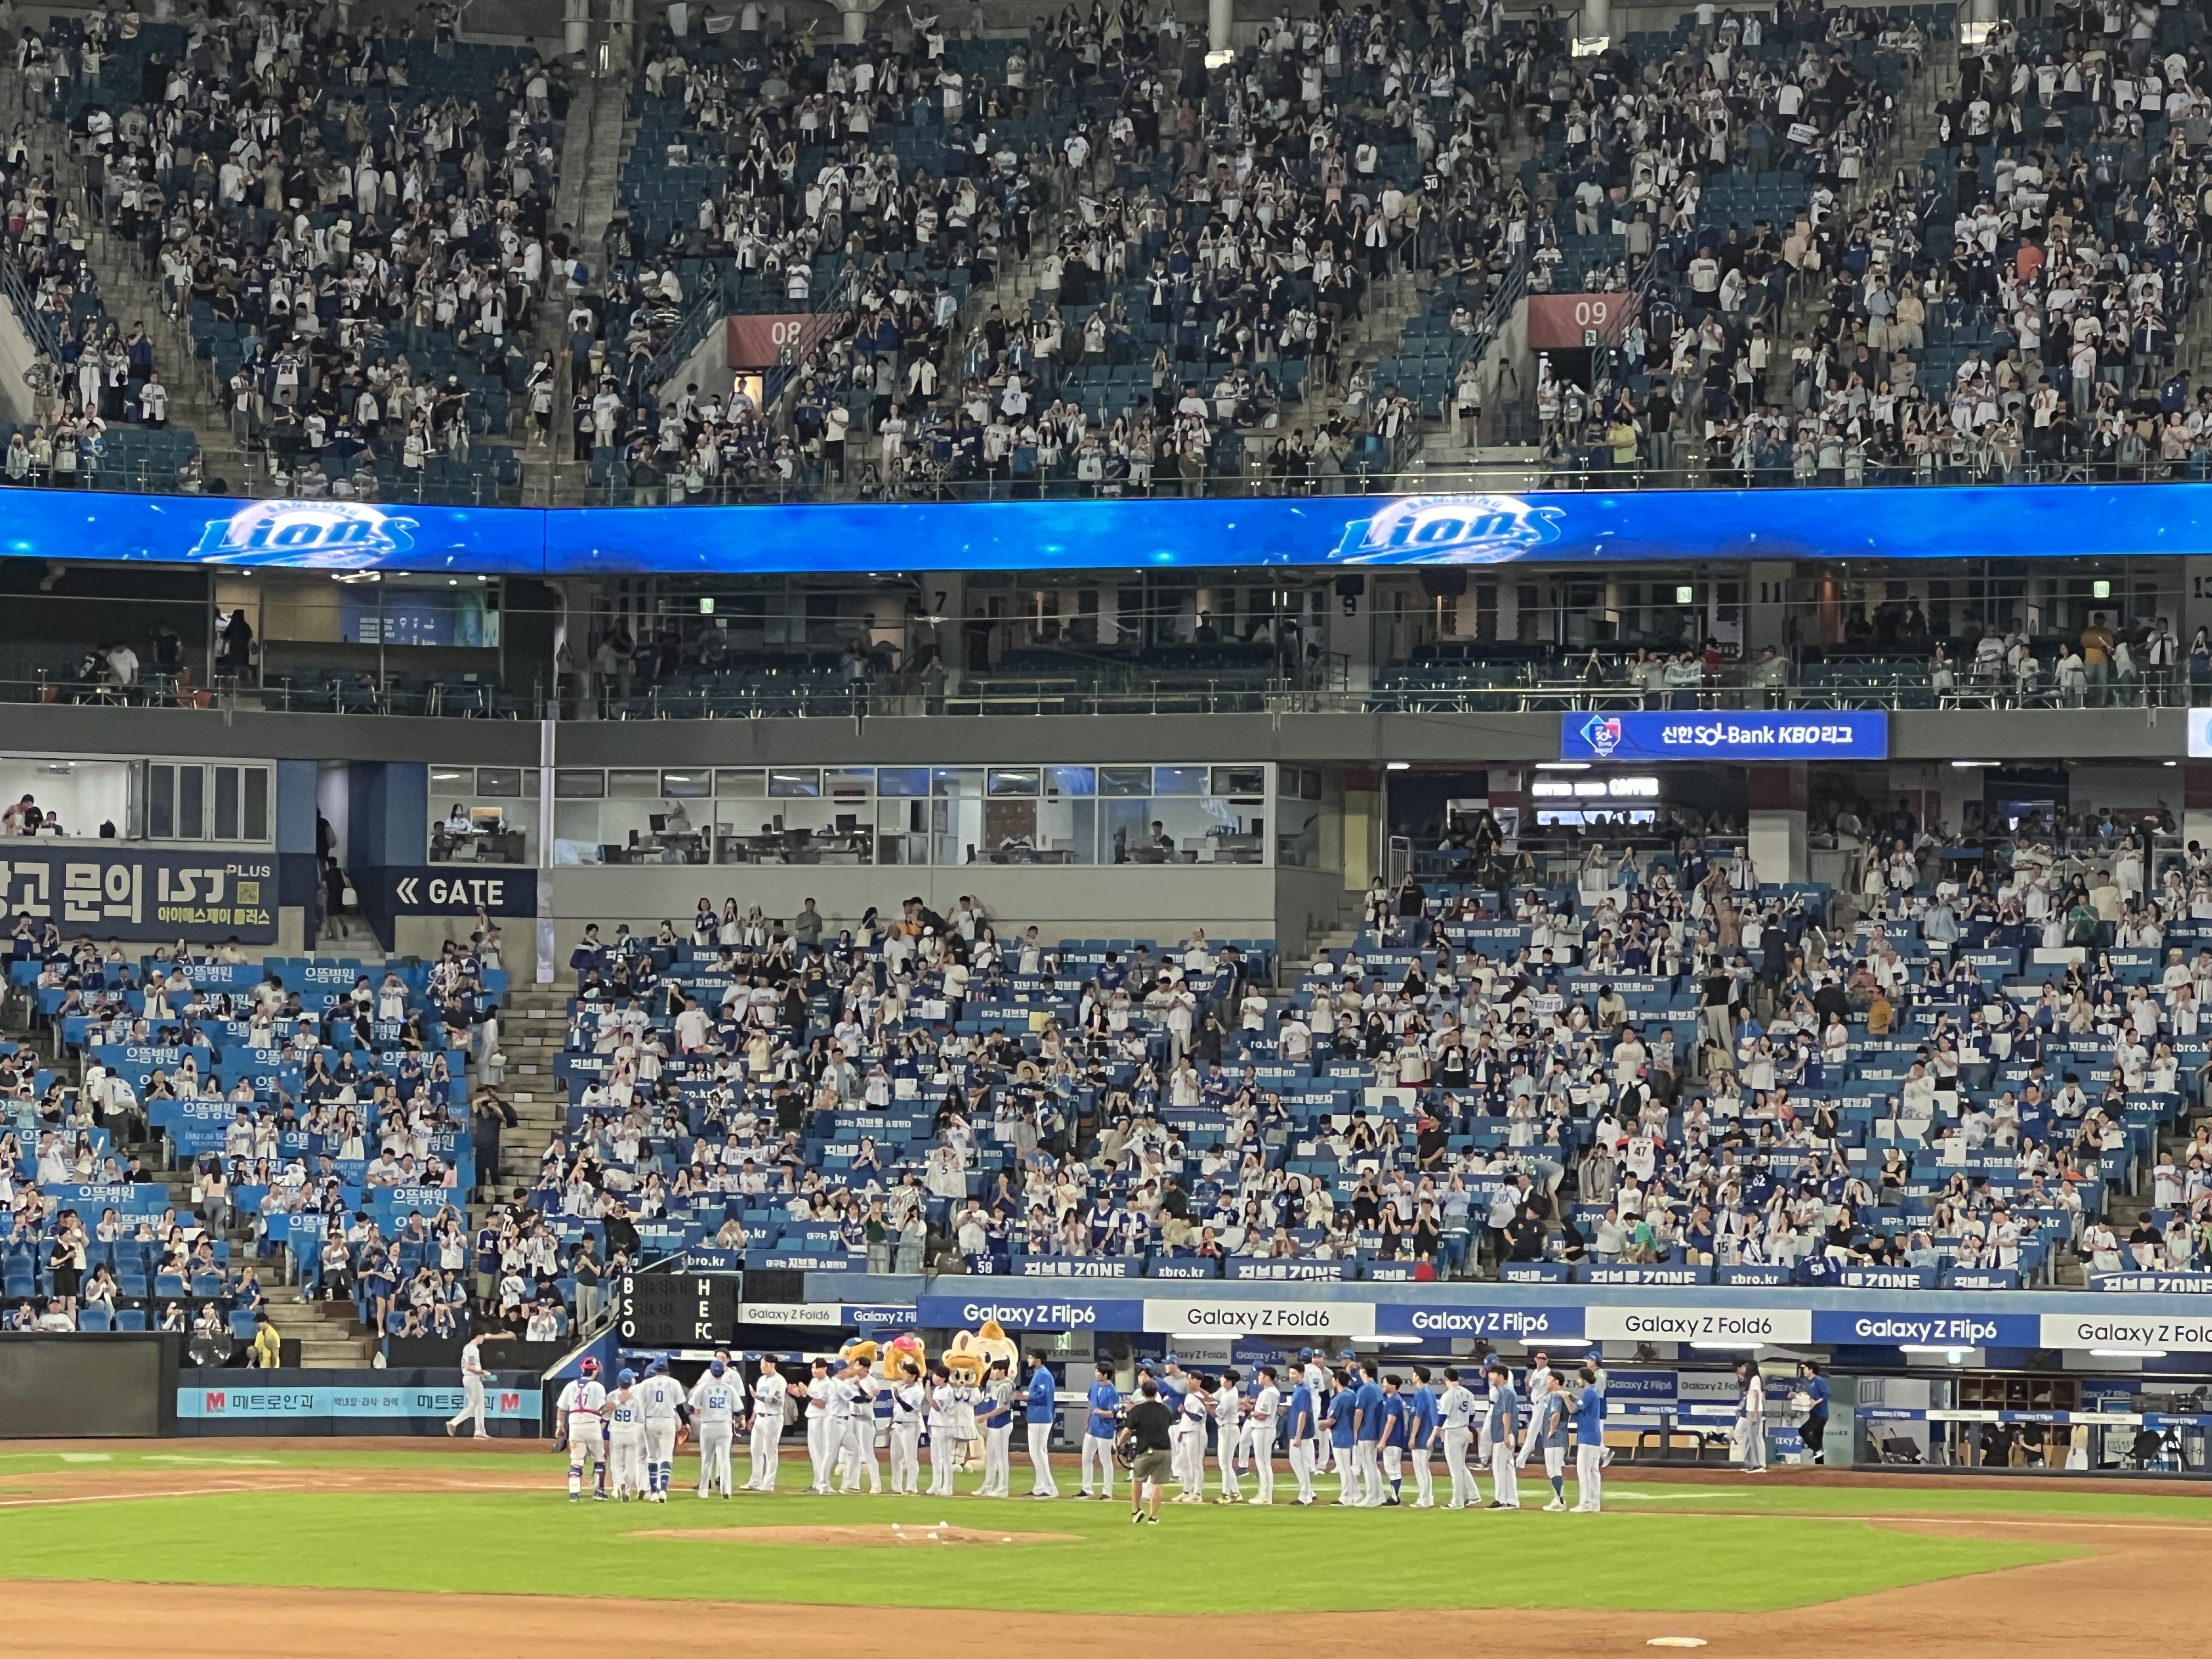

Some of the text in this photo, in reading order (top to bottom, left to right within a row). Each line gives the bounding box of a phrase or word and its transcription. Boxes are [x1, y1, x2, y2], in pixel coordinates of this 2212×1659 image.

[1575, 302, 1607, 325] 09
[772, 321, 802, 345] 08
[187, 517, 420, 556] Lions
[1327, 507, 1567, 558] Lions
[935, 591, 947, 613] 7
[1342, 595, 1357, 617] 9
[1662, 726, 1693, 743] 신한
[1778, 726, 1821, 743] KBO
[1821, 725, 1854, 743] 리그
[224, 864, 270, 877] PLUS
[64, 863, 143, 923] 문의
[429, 879, 504, 905] GATE
[1884, 927, 1908, 937] o.kr
[182, 965, 233, 983] 으뜸병원
[304, 967, 355, 984] 으뜸병원
[1251, 1039, 1278, 1049] ro.kr
[125, 1047, 179, 1064] 으뜸병원
[255, 1049, 309, 1067] 으뜸원
[382, 1051, 434, 1069] 으뜸원
[182, 1102, 237, 1120] 으뜸병원
[1634, 1147, 1647, 1156] 47
[823, 1173, 847, 1184] o.kr
[941, 1165, 948, 1175] 5
[78, 1186, 135, 1203] 으뜸병원
[392, 1188, 447, 1206] 으뜸병원
[121, 1214, 165, 1232] 뜸병원
[742, 1228, 767, 1239] o.kr
[1717, 1242, 1729, 1254] 15
[977, 1261, 992, 1274] 58
[1074, 1262, 1125, 1277] ZONE
[1289, 1266, 1341, 1282] ZONE
[624, 1278, 634, 1294] B
[1643, 1271, 1696, 1284] ZONE
[1865, 1273, 1920, 1288] ZONE
[2158, 1278, 2212, 1293] ZONE
[698, 1279, 710, 1296] H
[623, 1300, 633, 1317] S
[699, 1301, 709, 1318] E
[749, 1308, 830, 1322] Galaxy Z Fold6
[854, 1310, 896, 1324] Galaxy
[896, 1311, 904, 1322] Z
[964, 1304, 1096, 1328] Galaxy Z Flip6
[1187, 1308, 1330, 1330] Galaxy Z Fold6
[1412, 1311, 1548, 1336] Galaxy Z Flip6
[1625, 1316, 1772, 1338] Galaxy Z Fold6
[622, 1321, 635, 1338] O
[695, 1322, 712, 1340] FC
[1855, 1318, 1997, 1344] Galaxy Z Flip6
[2078, 1323, 2154, 1346] Galaxy
[2158, 1324, 2169, 1342] Z
[417, 1395, 495, 1410] 메트로과
[655, 1390, 663, 1403] 0
[709, 1397, 726, 1409] 62
[614, 1409, 631, 1423] 68
